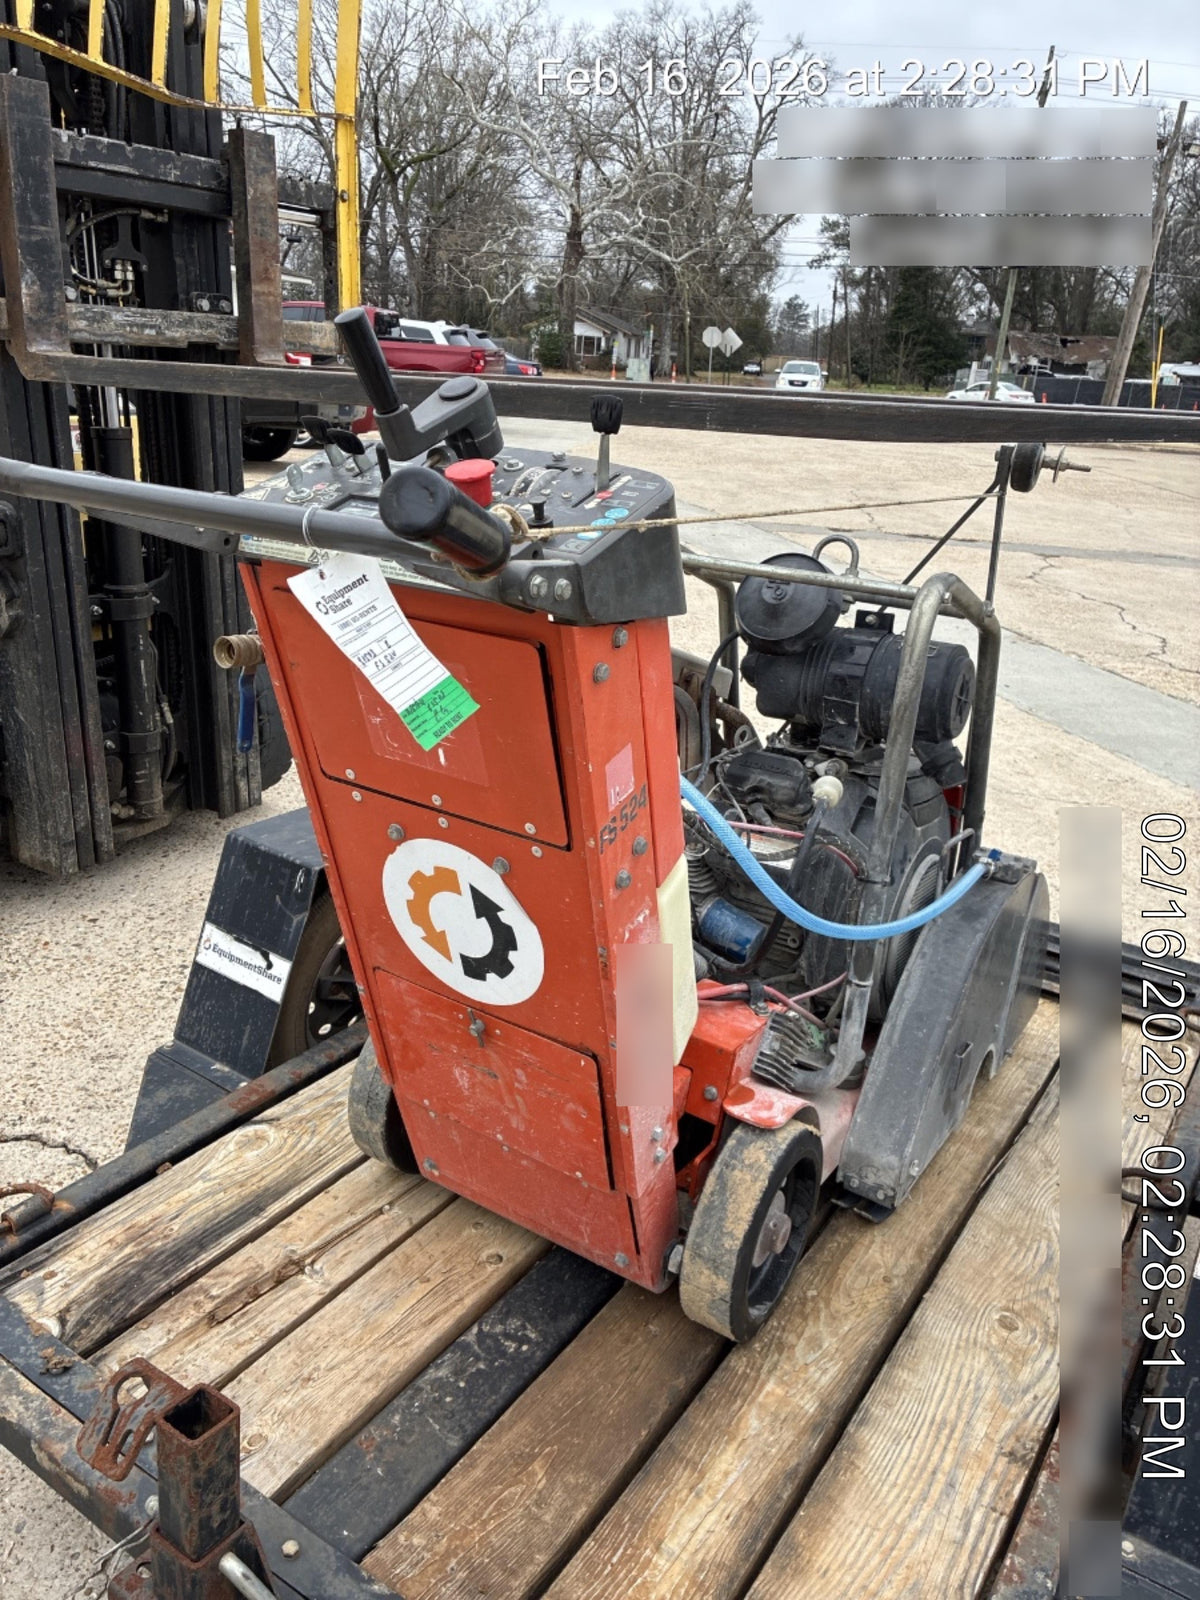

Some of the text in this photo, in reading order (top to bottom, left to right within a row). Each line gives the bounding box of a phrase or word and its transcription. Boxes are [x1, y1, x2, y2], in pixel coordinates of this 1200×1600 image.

[320, 574, 369, 605] Equipment
[329, 598, 353, 614] Share
[212, 943, 283, 984] EquipmentShare
